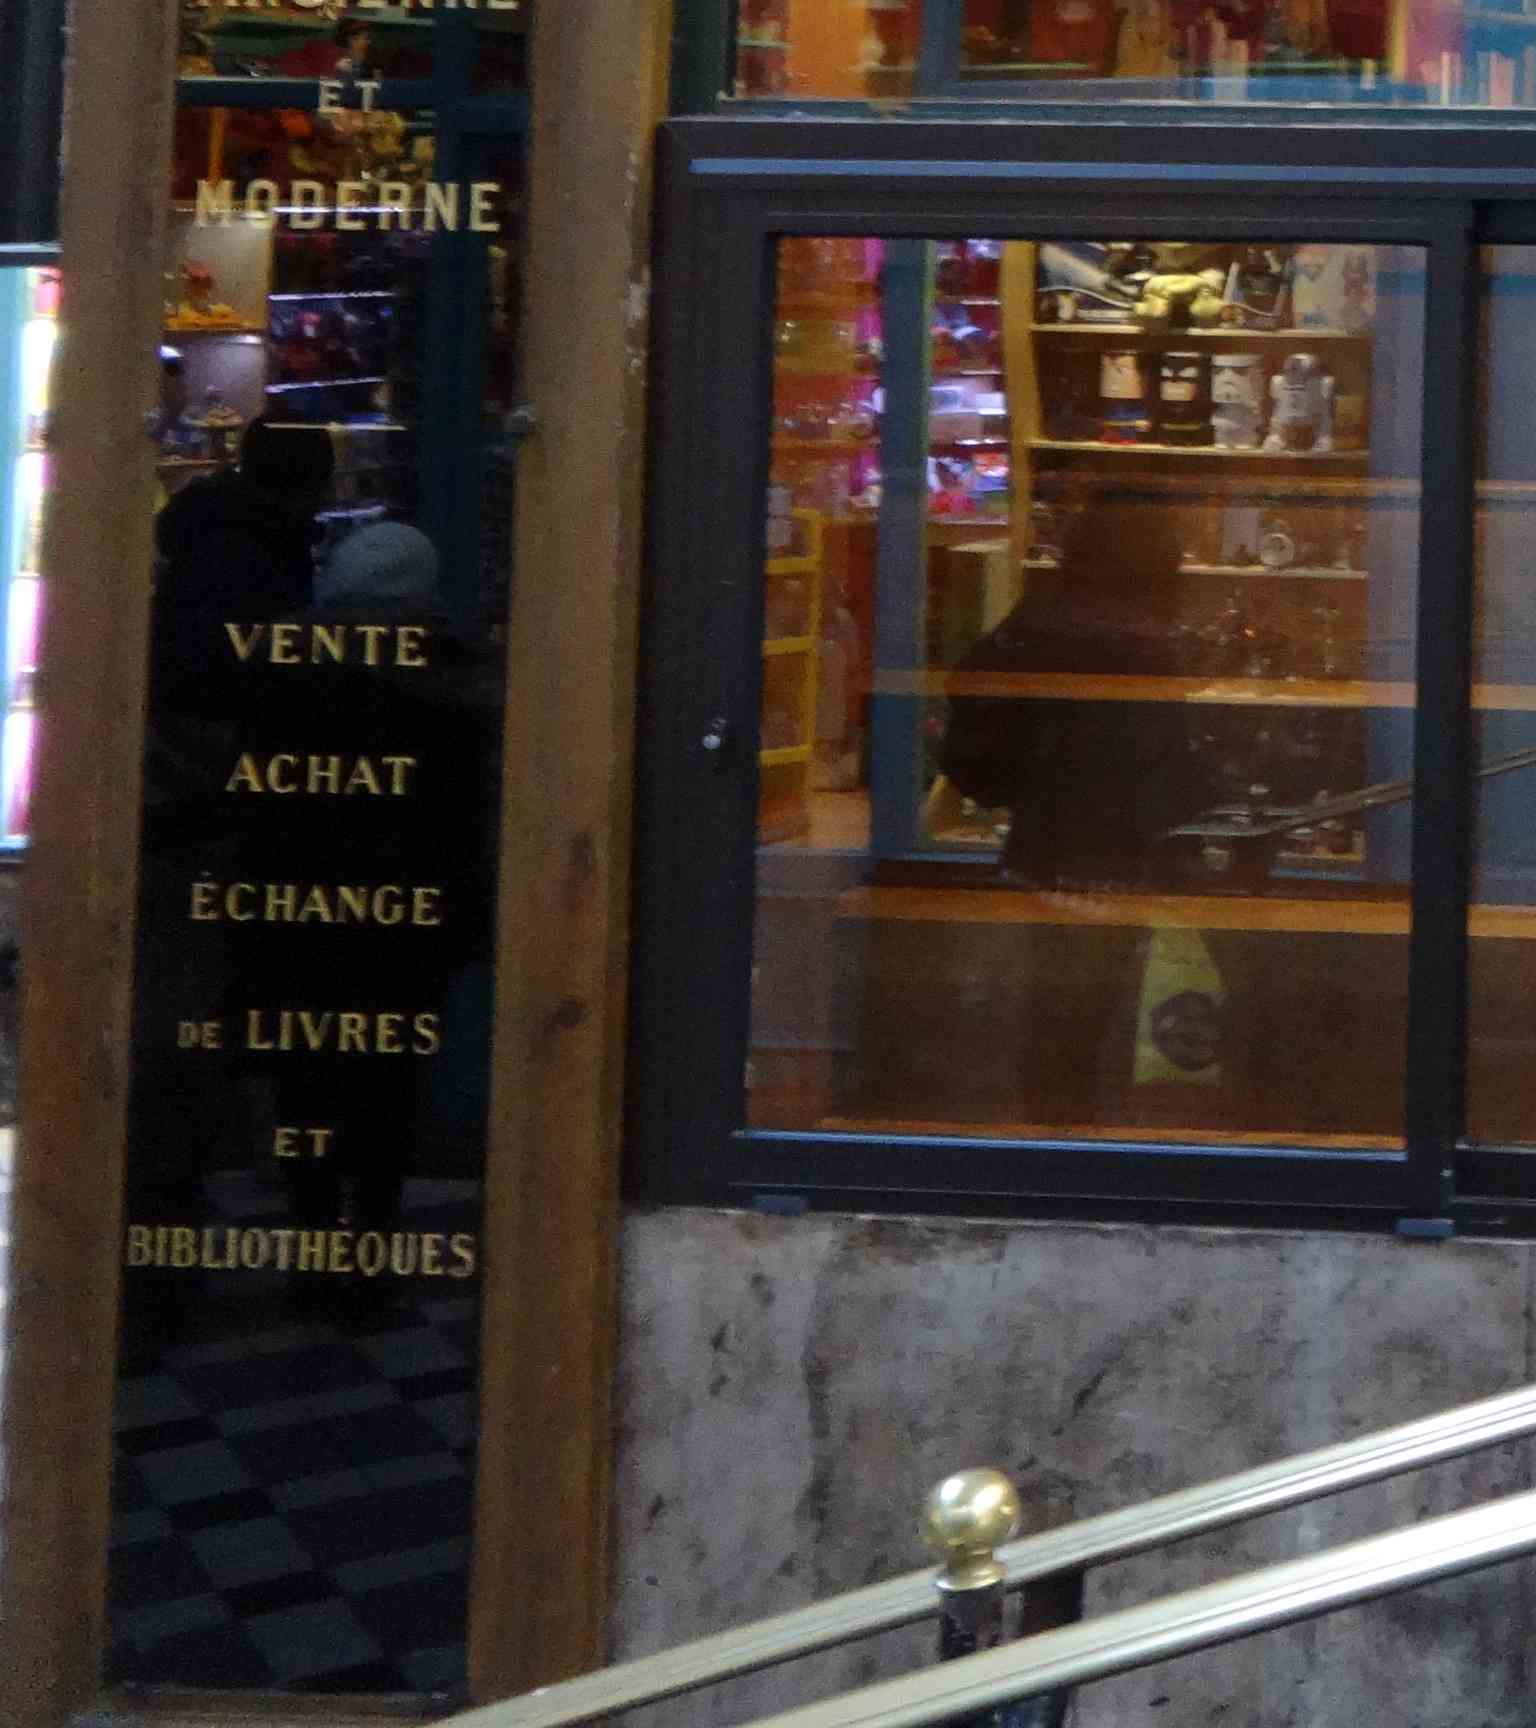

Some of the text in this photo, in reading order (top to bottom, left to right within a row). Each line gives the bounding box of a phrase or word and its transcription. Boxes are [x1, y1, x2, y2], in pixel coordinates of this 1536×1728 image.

[318, 80, 382, 113] ET
[194, 179, 501, 230] MODERNE
[224, 622, 429, 667] VENTE
[226, 752, 417, 796] ACHAT
[177, 1010, 441, 1055] DE LIVRES
[273, 1127, 333, 1158] ET
